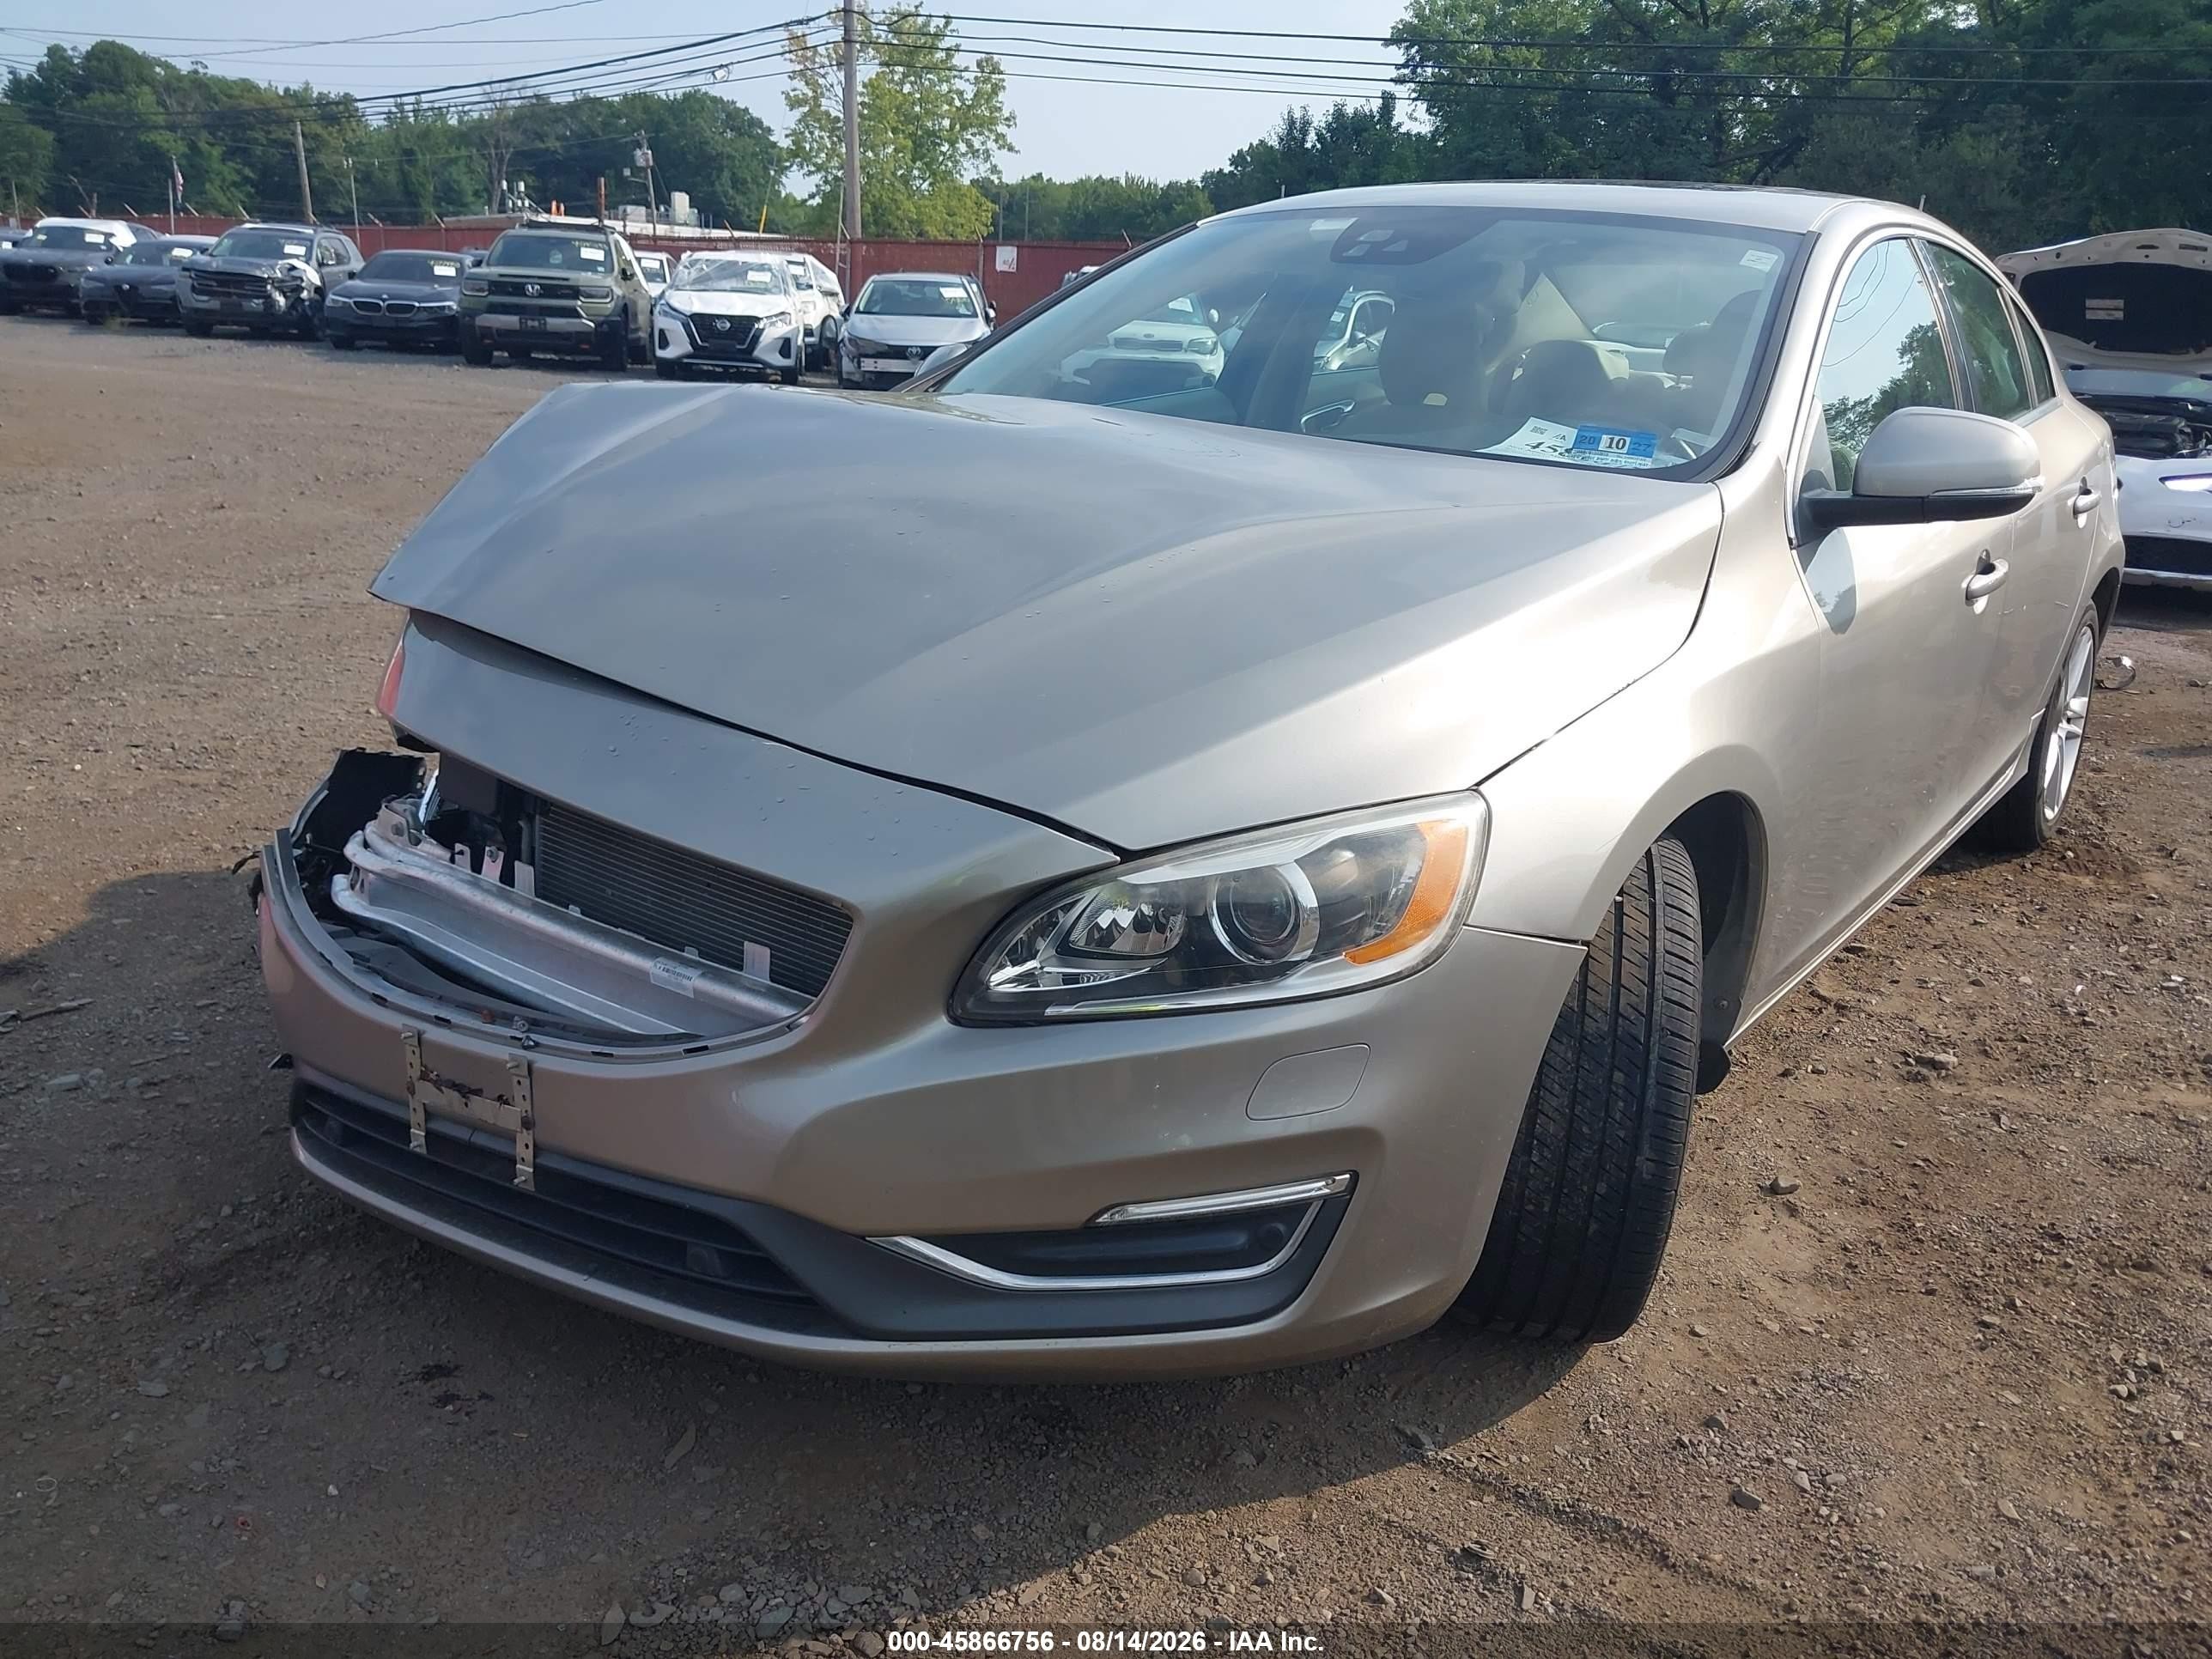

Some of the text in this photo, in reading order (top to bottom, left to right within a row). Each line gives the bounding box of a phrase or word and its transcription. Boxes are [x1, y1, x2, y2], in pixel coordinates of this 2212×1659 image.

[1579, 434, 1651, 452] 20 10 27
